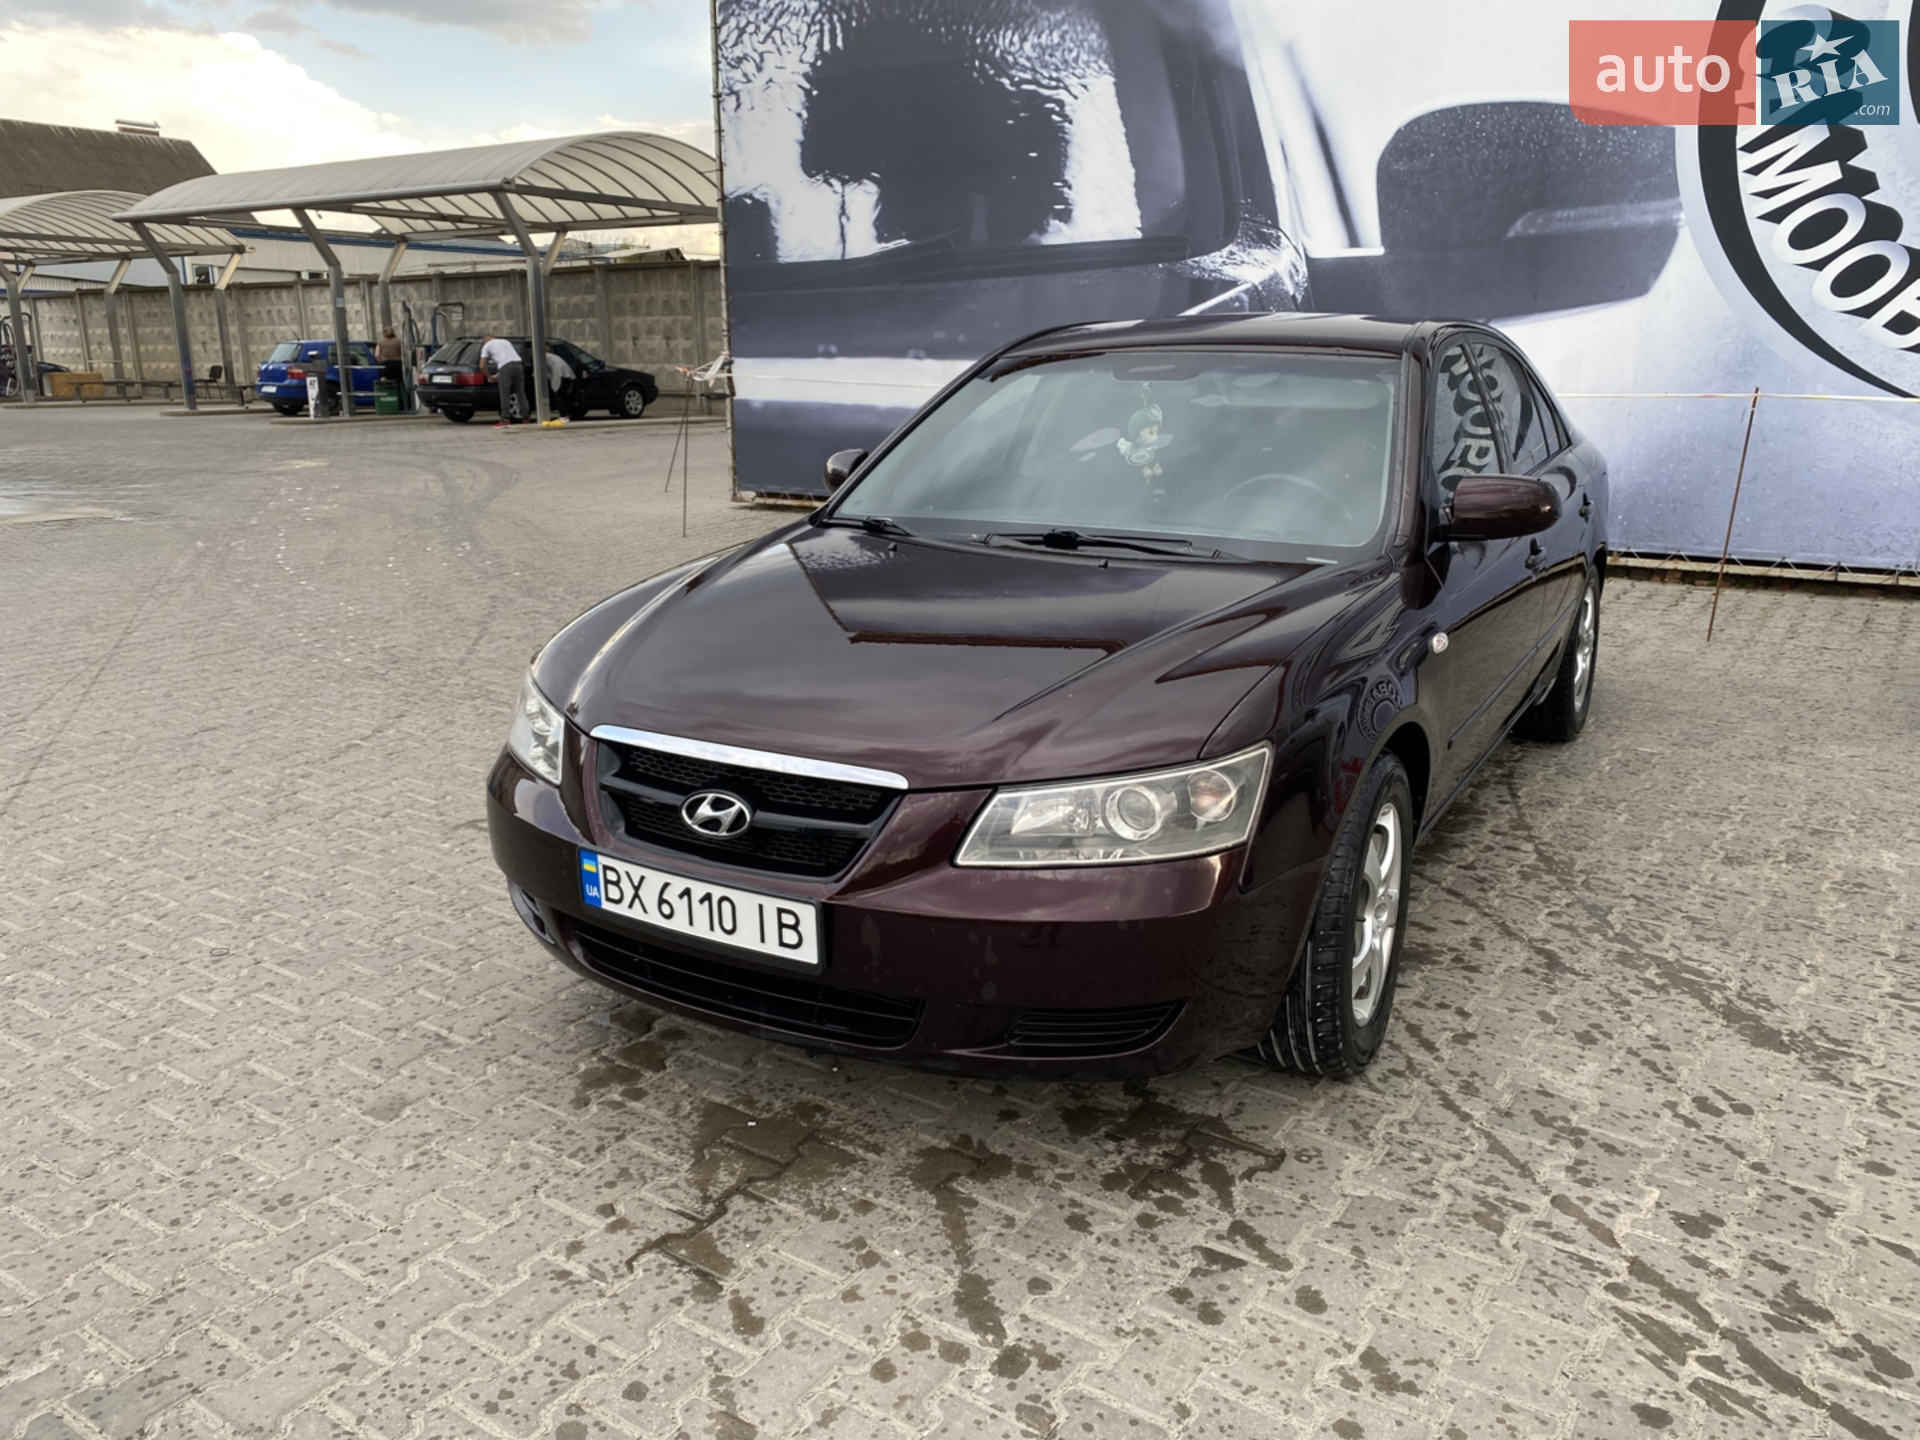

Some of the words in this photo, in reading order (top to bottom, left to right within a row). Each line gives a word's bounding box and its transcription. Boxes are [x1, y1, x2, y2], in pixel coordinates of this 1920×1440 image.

[586, 884, 599, 897] UA
[602, 864, 648, 914] BX
[657, 882, 736, 935] 6110
[758, 903, 803, 950] IB
